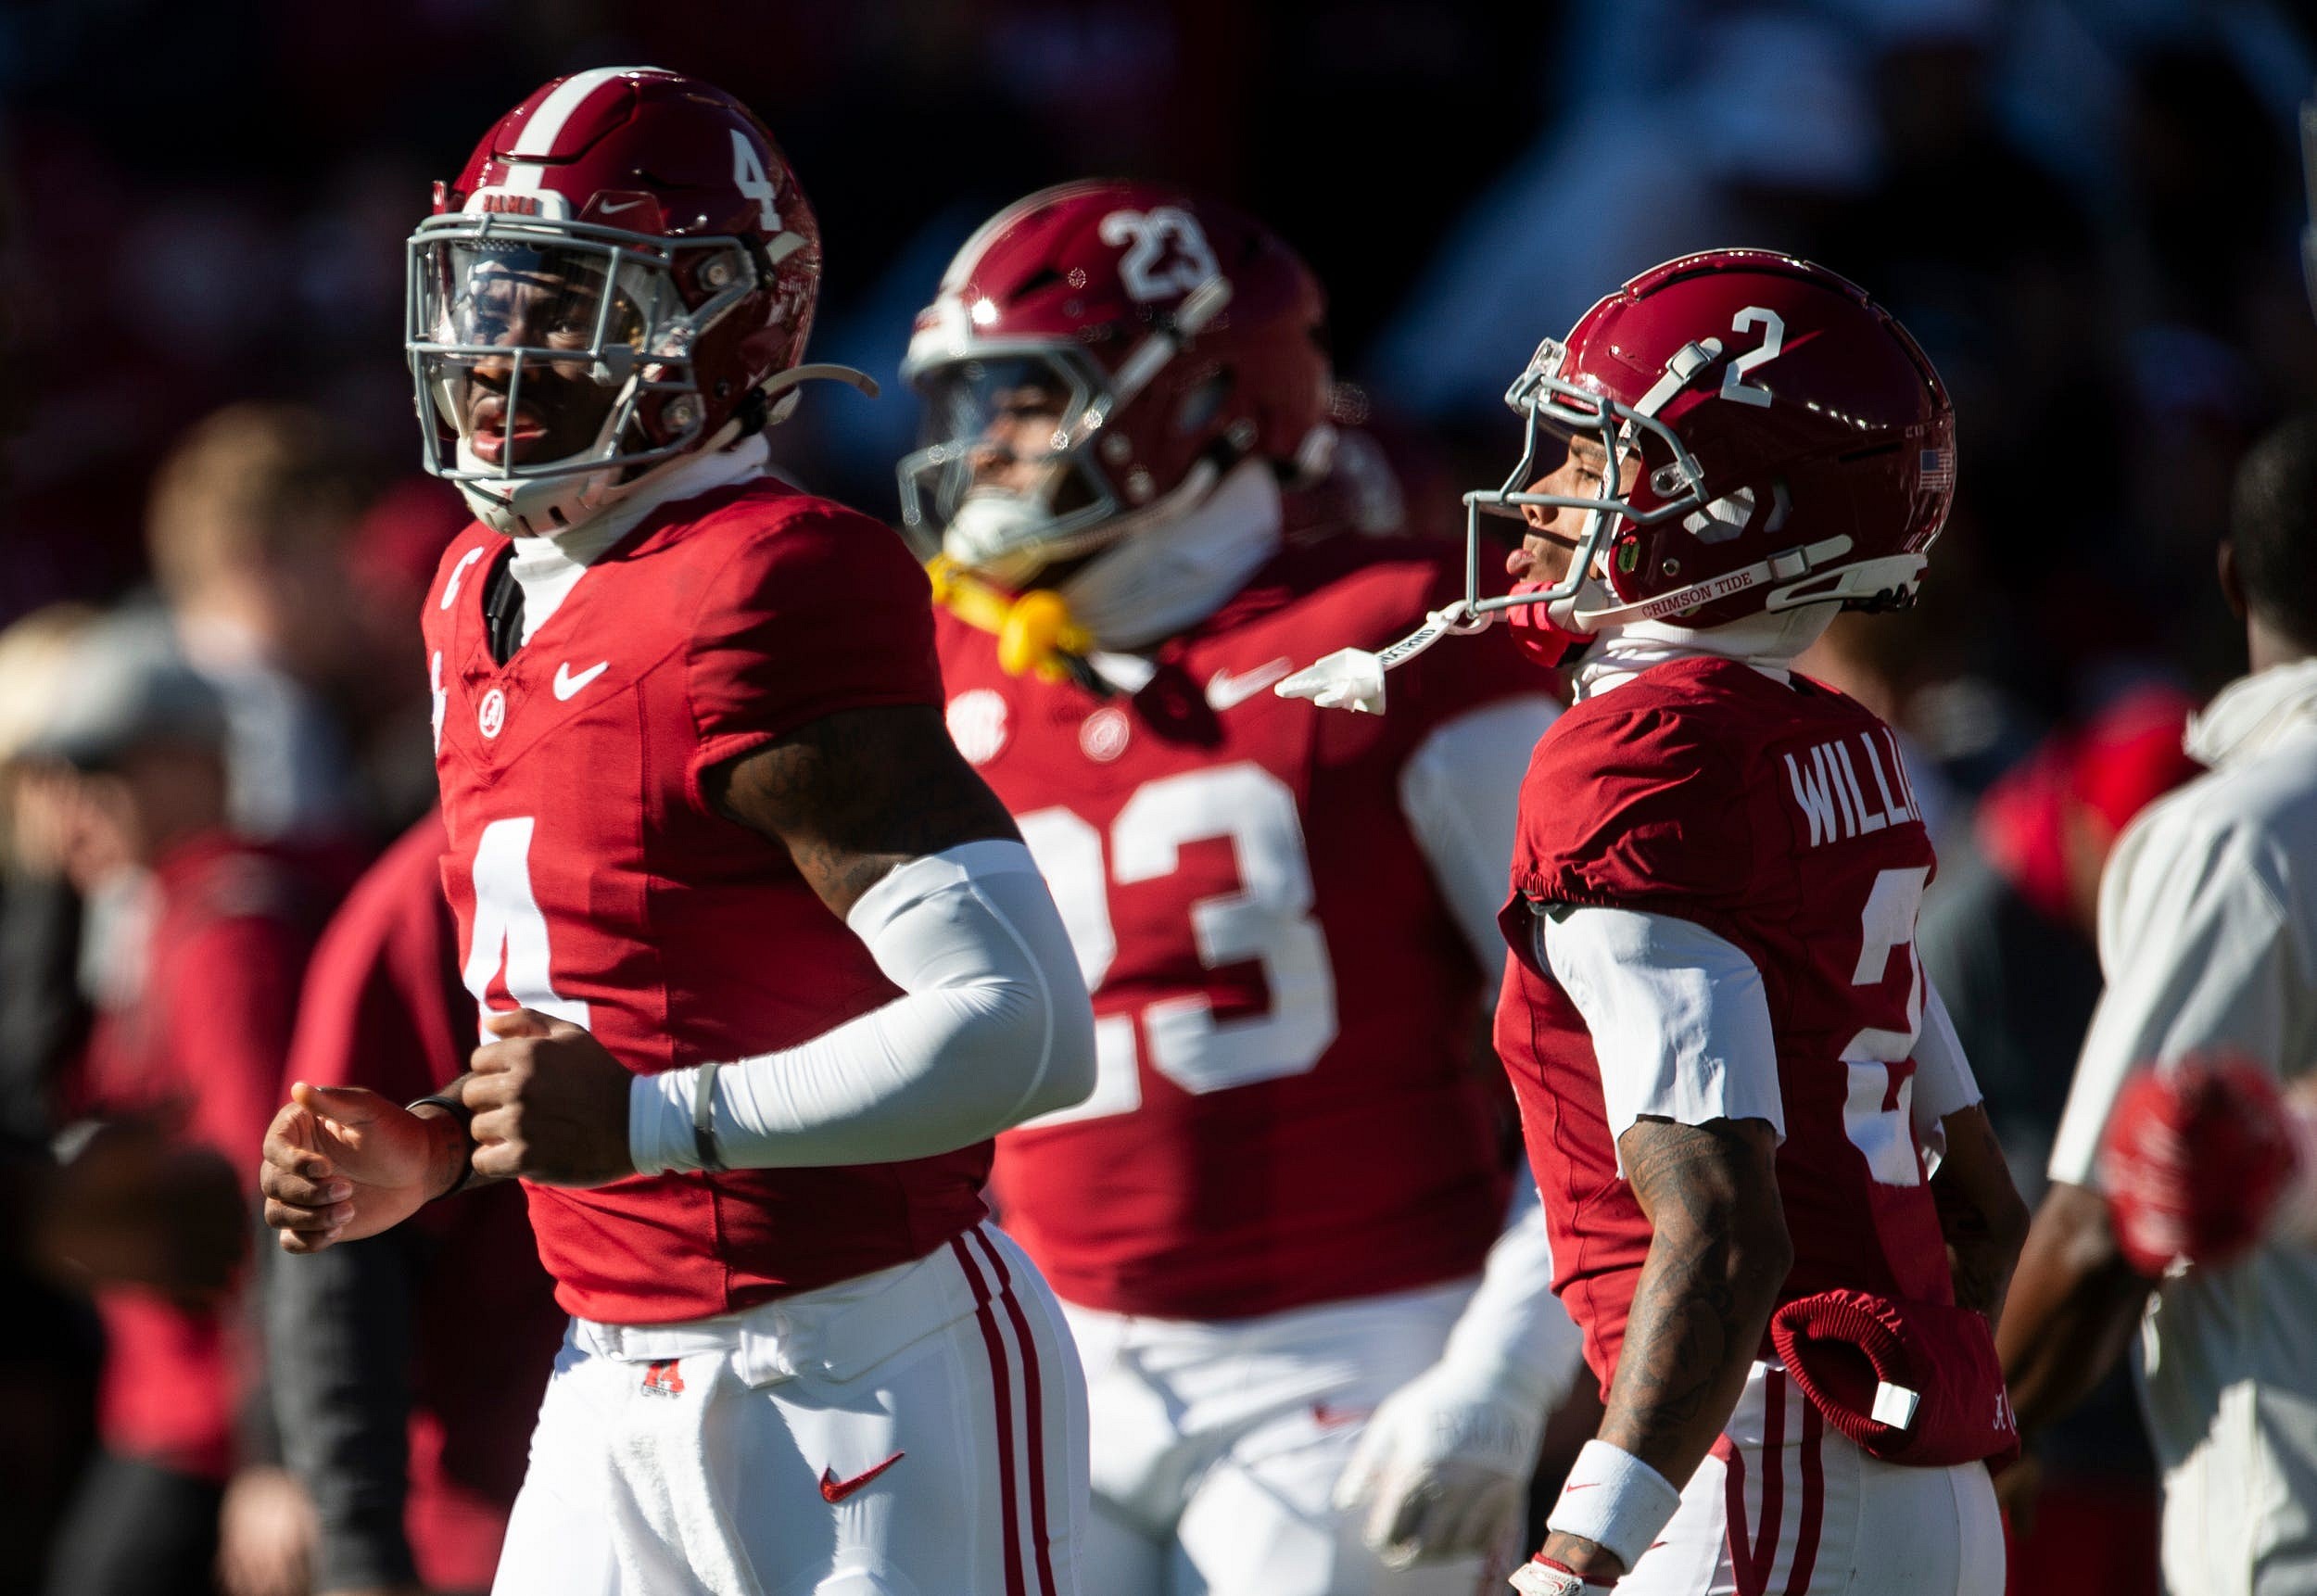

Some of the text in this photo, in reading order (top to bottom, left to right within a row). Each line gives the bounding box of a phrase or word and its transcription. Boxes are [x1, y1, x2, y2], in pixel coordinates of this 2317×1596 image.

[729, 129, 782, 231] 4
[1097, 206, 1222, 302] 23
[1720, 305, 1785, 408] 2
[1641, 572, 1754, 619] CRIMSON TIDE
[1784, 726, 1919, 847] WILLI
[463, 816, 591, 1045] 4
[1838, 866, 1931, 1186] 2
